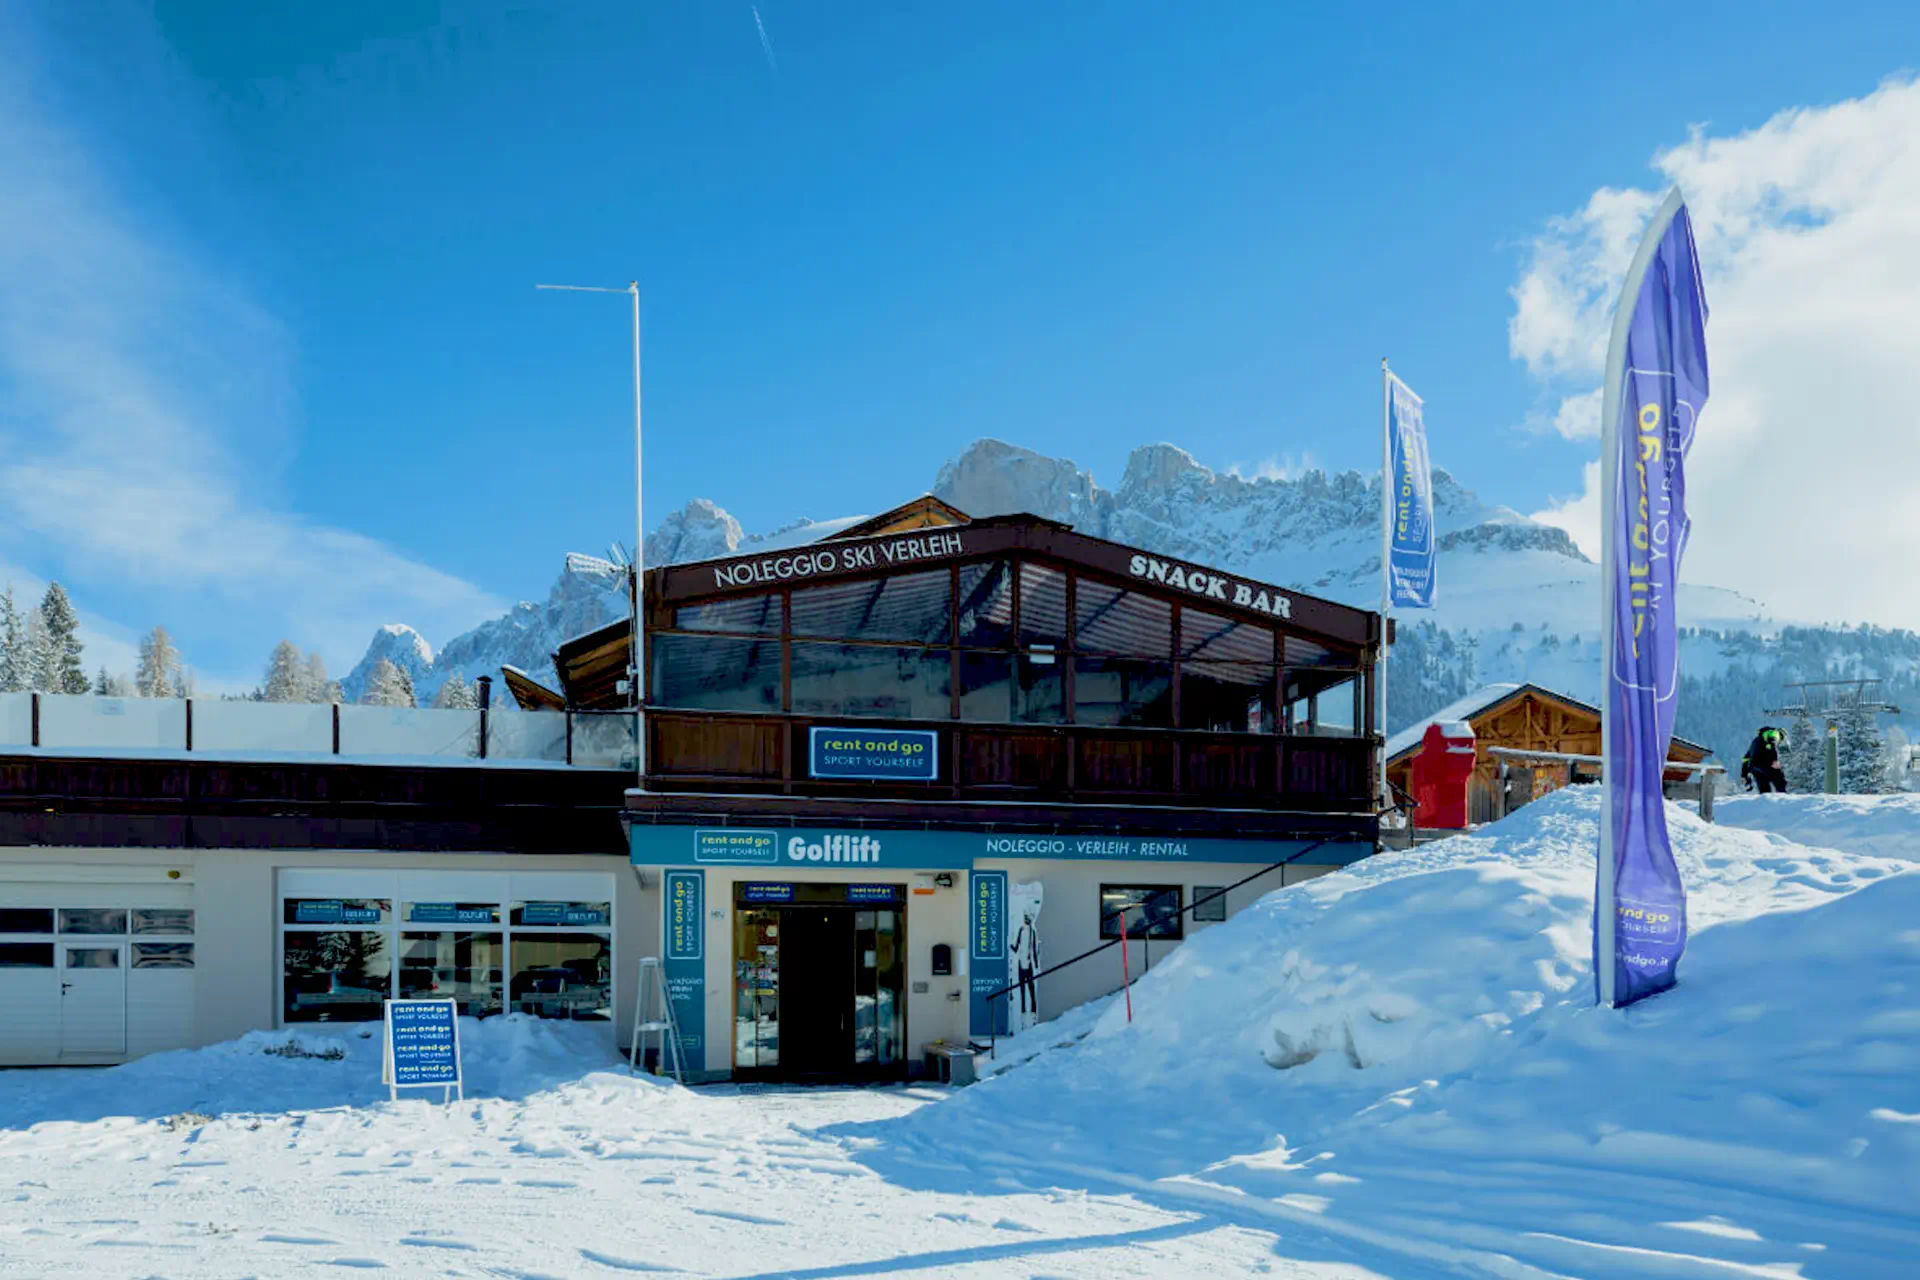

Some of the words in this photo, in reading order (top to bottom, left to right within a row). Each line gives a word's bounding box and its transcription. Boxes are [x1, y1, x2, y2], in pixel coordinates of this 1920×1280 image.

[1397, 500, 1411, 541] rent
[713, 551, 837, 588] NOLEGGIO
[842, 546, 876, 569] SKI
[880, 533, 963, 564] VERLEIH
[1129, 554, 1228, 600] SNACK
[1231, 583, 1292, 619] BAR
[824, 740, 862, 750] rent
[865, 740, 898, 752] and
[901, 743, 924, 755] go
[824, 756, 861, 765] SPORT
[866, 756, 925, 767] YOURSELF
[702, 836, 728, 844] rent
[730, 836, 753, 845] and
[755, 838, 771, 847] go
[787, 834, 881, 862] Golflift
[986, 839, 1065, 853] NOLEGGIO
[1076, 841, 1130, 855] VERLEIH
[1140, 842, 1189, 856] RENTAL
[675, 881, 686, 898] go
[980, 882, 989, 898] go
[674, 899, 684, 924] and
[978, 899, 987, 924] and
[1646, 913, 1670, 924] go
[674, 925, 684, 952] rent
[979, 926, 987, 952] rent
